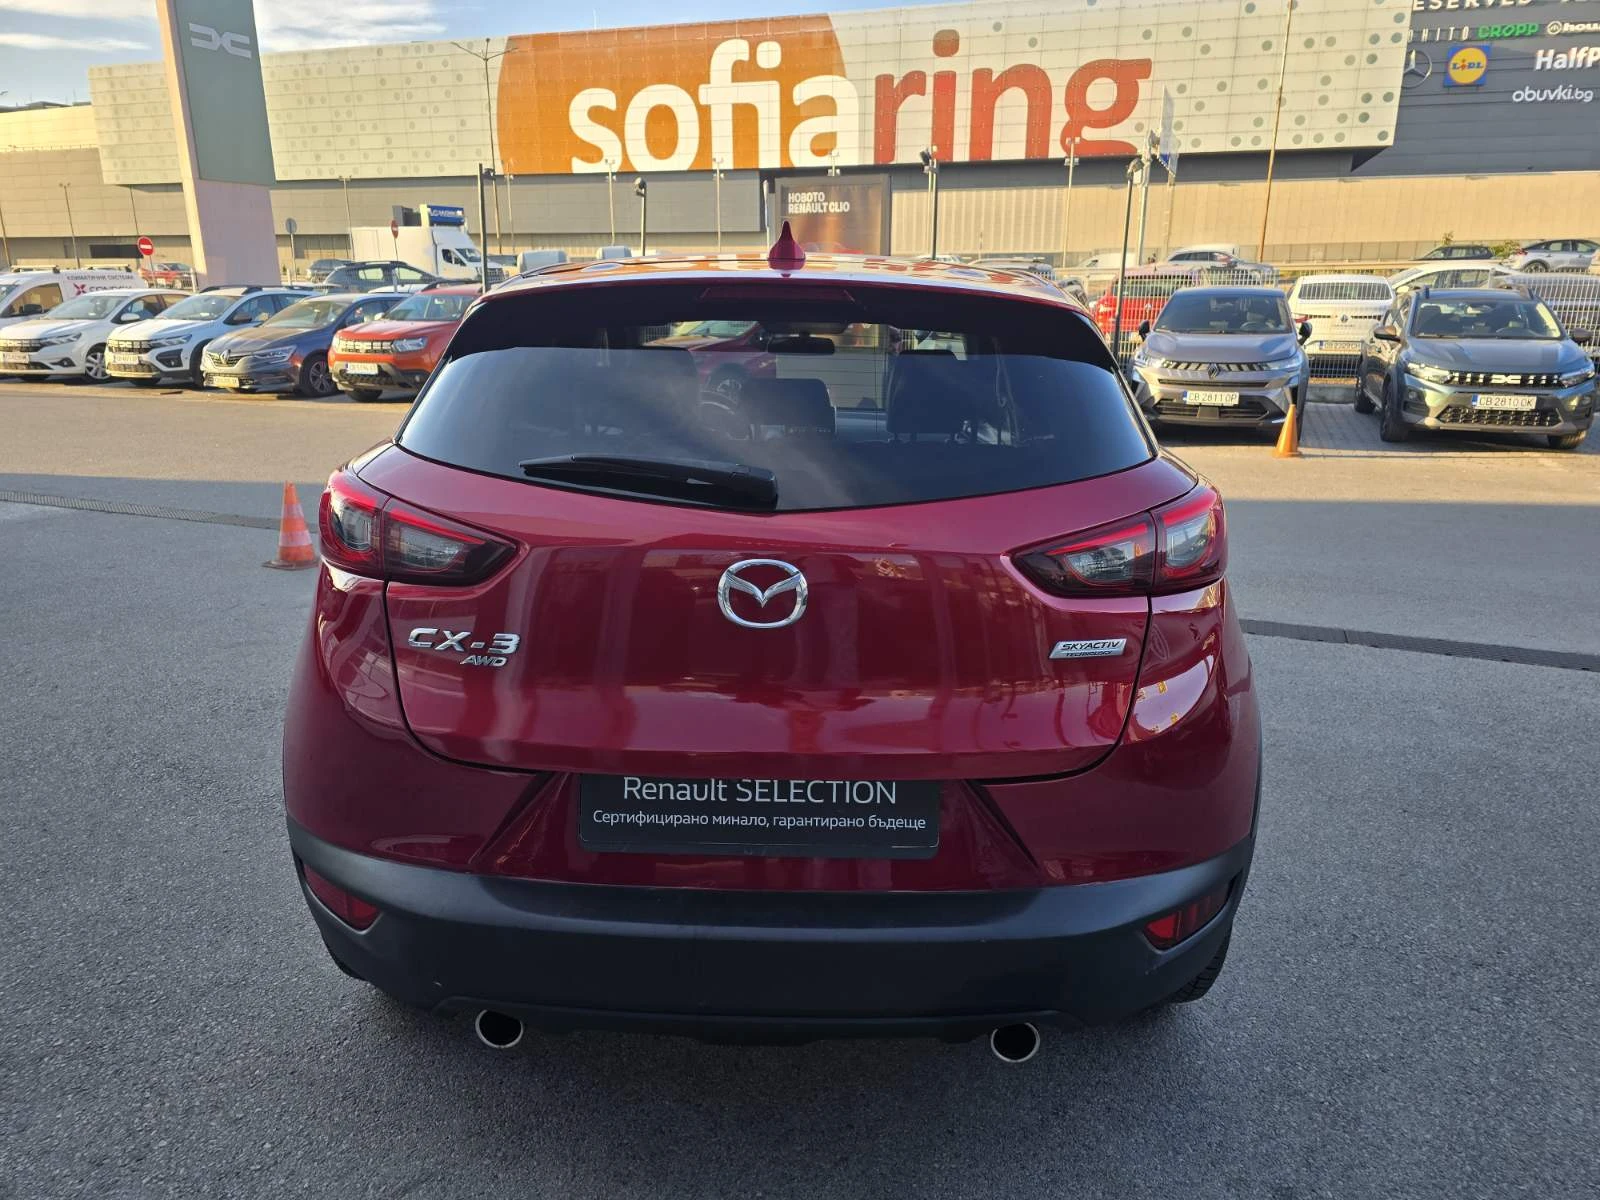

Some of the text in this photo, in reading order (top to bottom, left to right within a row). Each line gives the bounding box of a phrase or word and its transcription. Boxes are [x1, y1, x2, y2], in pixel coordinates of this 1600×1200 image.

[1563, 22, 1600, 33] hou
[1512, 84, 1594, 102] obuvki.bg
[788, 201, 850, 214] RENAULT CLIO
[407, 627, 521, 654] CX-3
[1060, 641, 1120, 651] SKYACTIV
[459, 654, 508, 667] AWD
[623, 776, 896, 804] Renault SELECTION
[593, 810, 926, 831] Сертифицирано минало, гарантирано бъдеще
